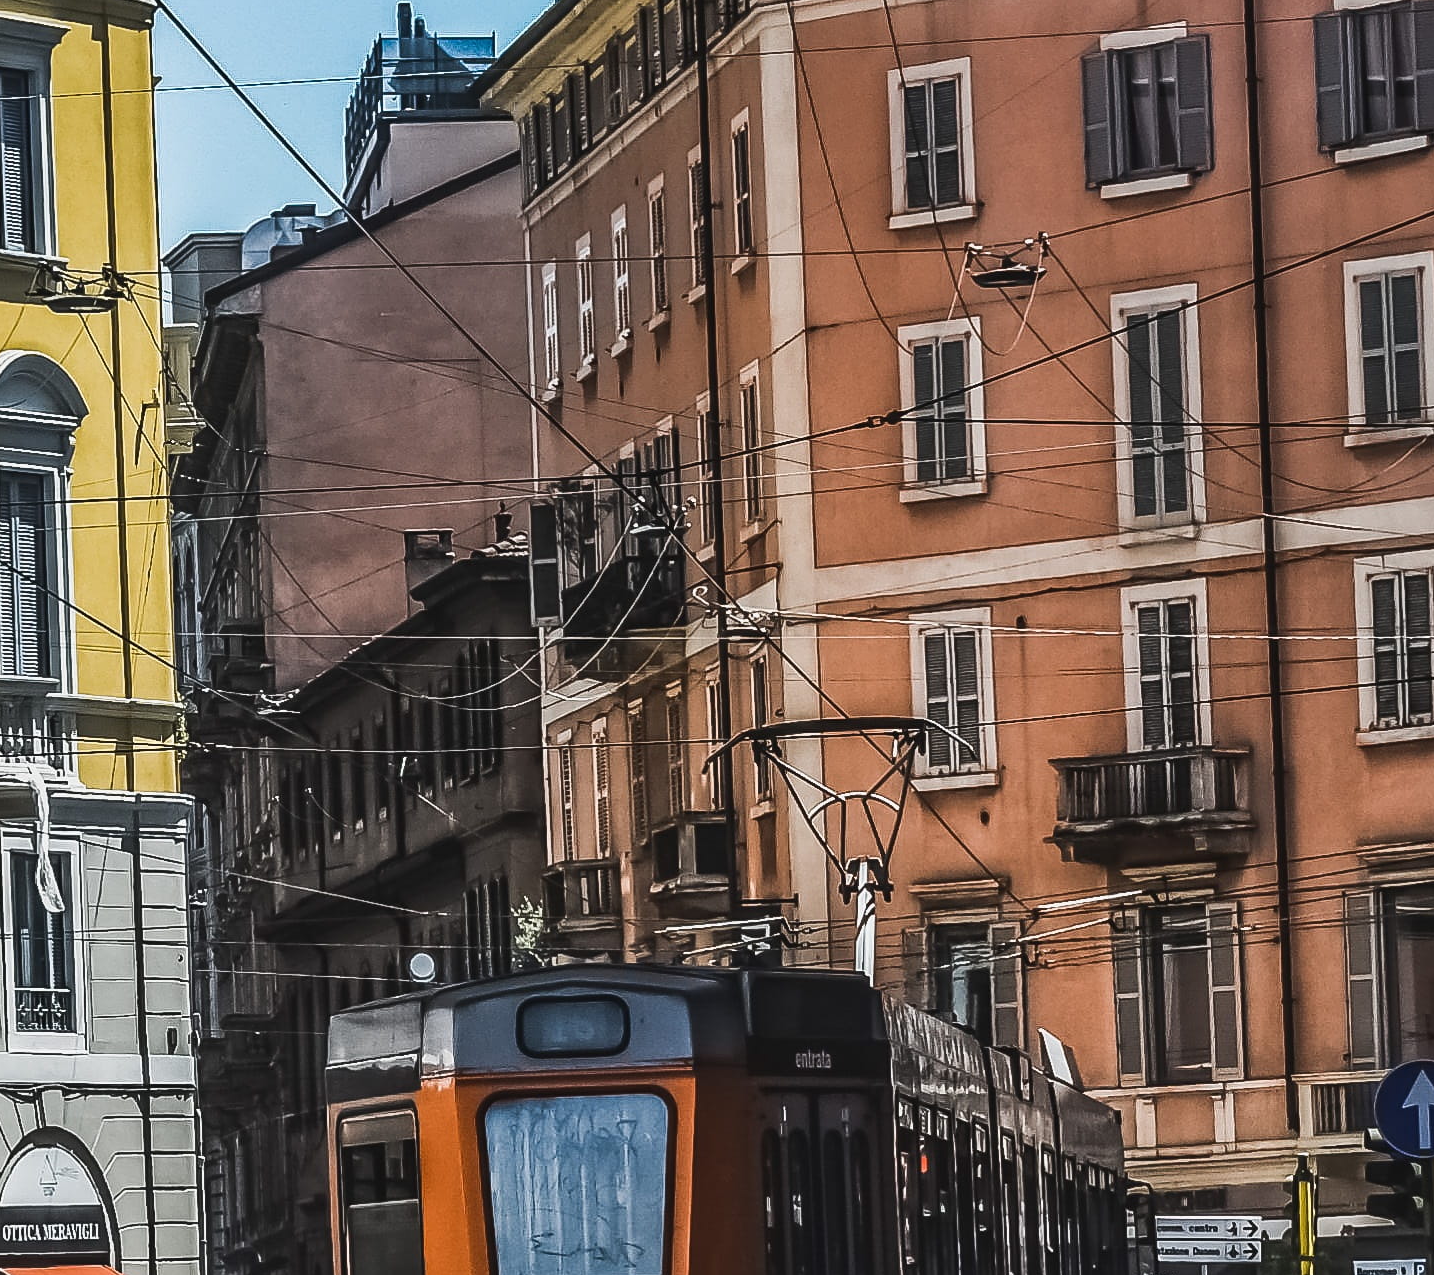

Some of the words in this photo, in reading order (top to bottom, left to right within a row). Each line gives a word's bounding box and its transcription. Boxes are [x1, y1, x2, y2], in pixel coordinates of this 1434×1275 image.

[795, 1049, 832, 1069] entrata
[2, 1224, 43, 1242] OTTICA
[43, 1223, 100, 1241] MERAVIGLI
